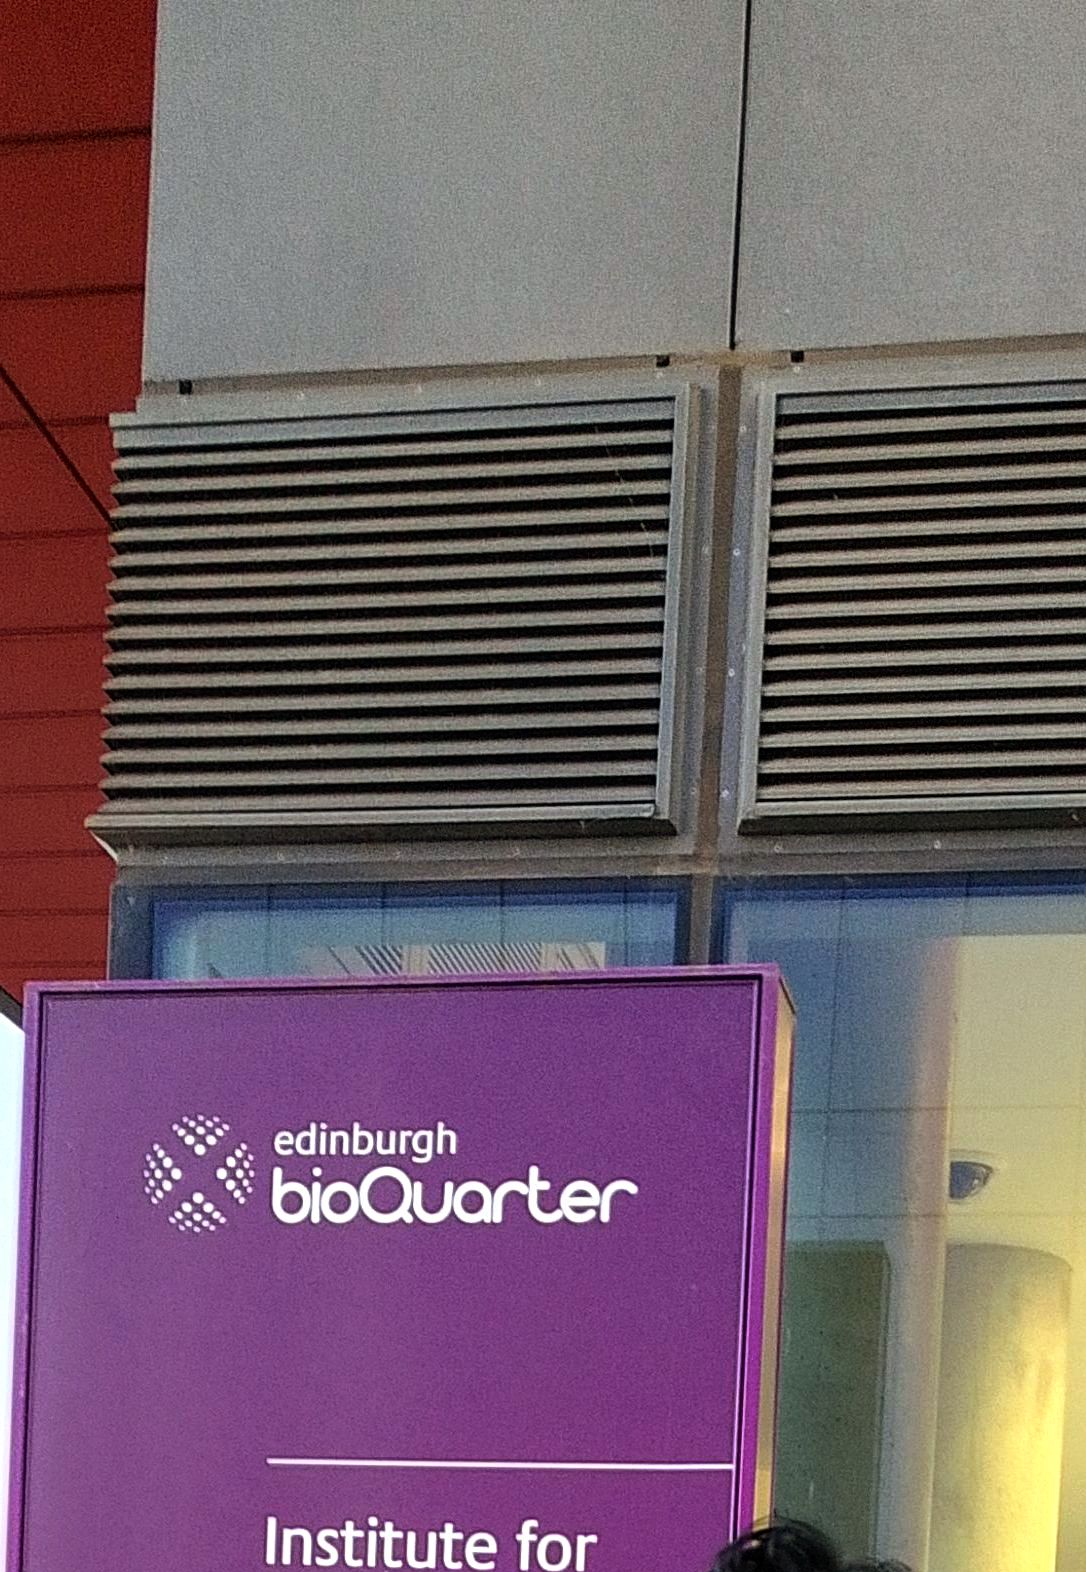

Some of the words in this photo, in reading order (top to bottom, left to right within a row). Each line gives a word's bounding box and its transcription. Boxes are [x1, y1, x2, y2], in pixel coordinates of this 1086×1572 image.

[273, 1121, 457, 1163] edinburgh
[271, 1165, 639, 1224] bioQuarter
[265, 1516, 498, 1571] Institute
[515, 1519, 598, 1572] for
